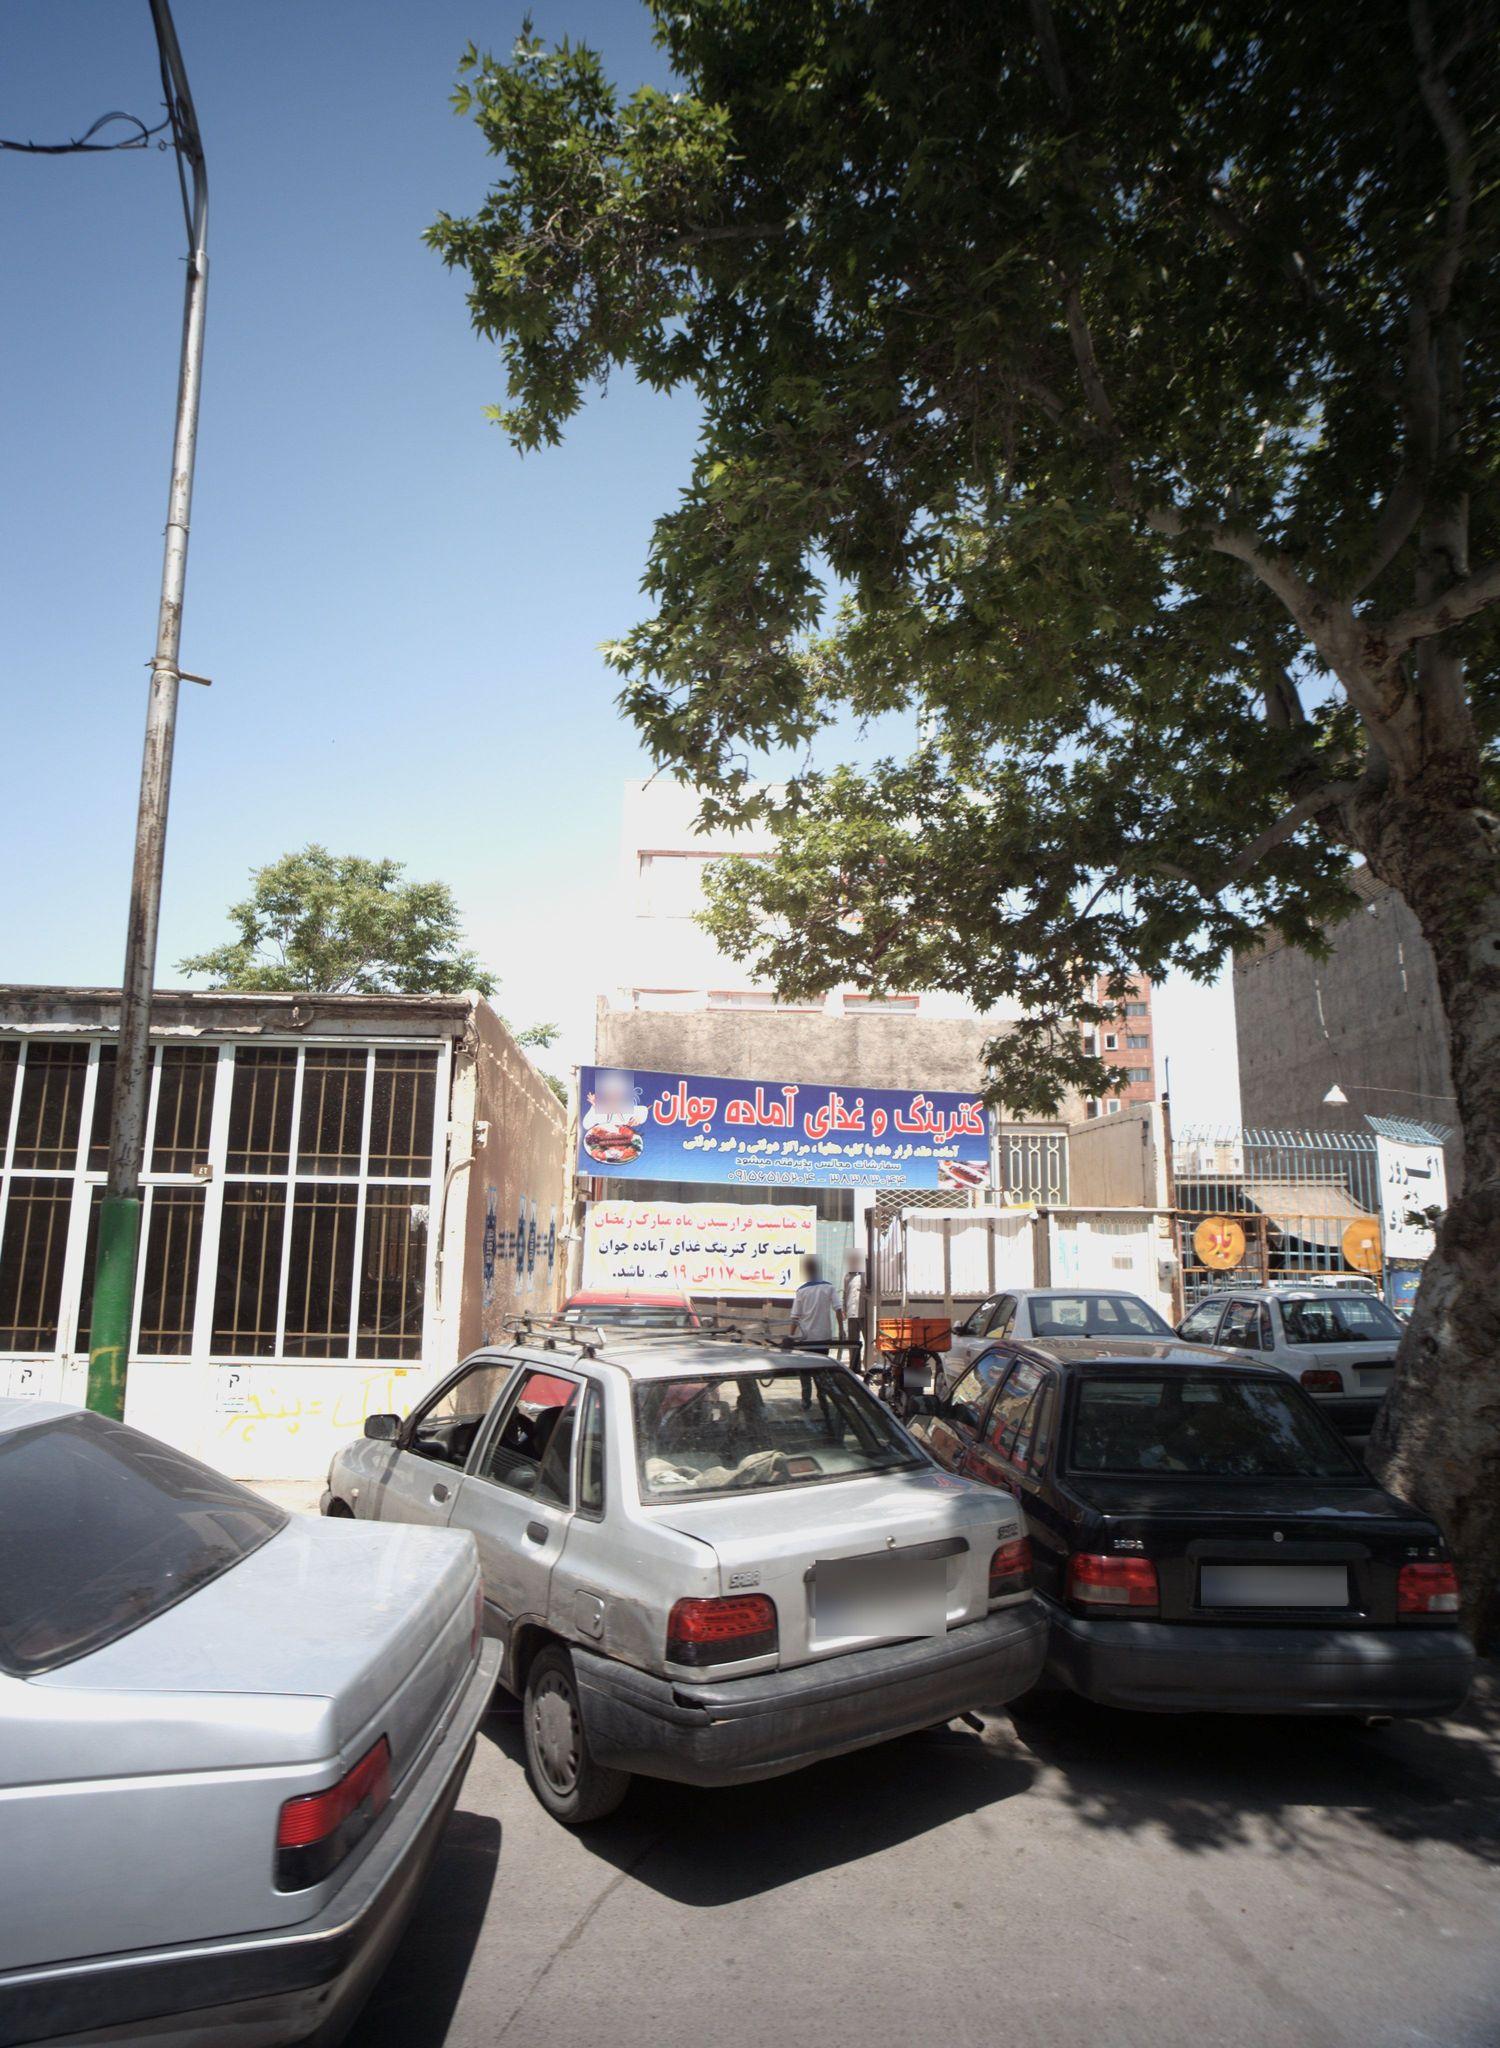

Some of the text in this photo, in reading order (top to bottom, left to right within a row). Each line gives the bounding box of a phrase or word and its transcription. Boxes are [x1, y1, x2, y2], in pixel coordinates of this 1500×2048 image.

[652, 1080, 985, 1143] کترینگ و غذای آماده جوان
[594, 1212, 633, 1229] رمضان
[635, 1213, 673, 1229] مبارک
[675, 1214, 694, 1226] ماه
[757, 1216, 798, 1231] مناسبت
[801, 1218, 812, 1230] به
[598, 1239, 630, 1255] جوان
[633, 1238, 666, 1252] آماده
[669, 1240, 701, 1256] غذای
[751, 1242, 770, 1259] کار
[773, 1243, 806, 1255] ساعت
[673, 1264, 687, 1280] ۱۹
[692, 1266, 715, 1283] الی
[719, 1266, 735, 1280] ۱۷
[740, 1268, 775, 1281] ساعت
[780, 1268, 791, 1286] از
